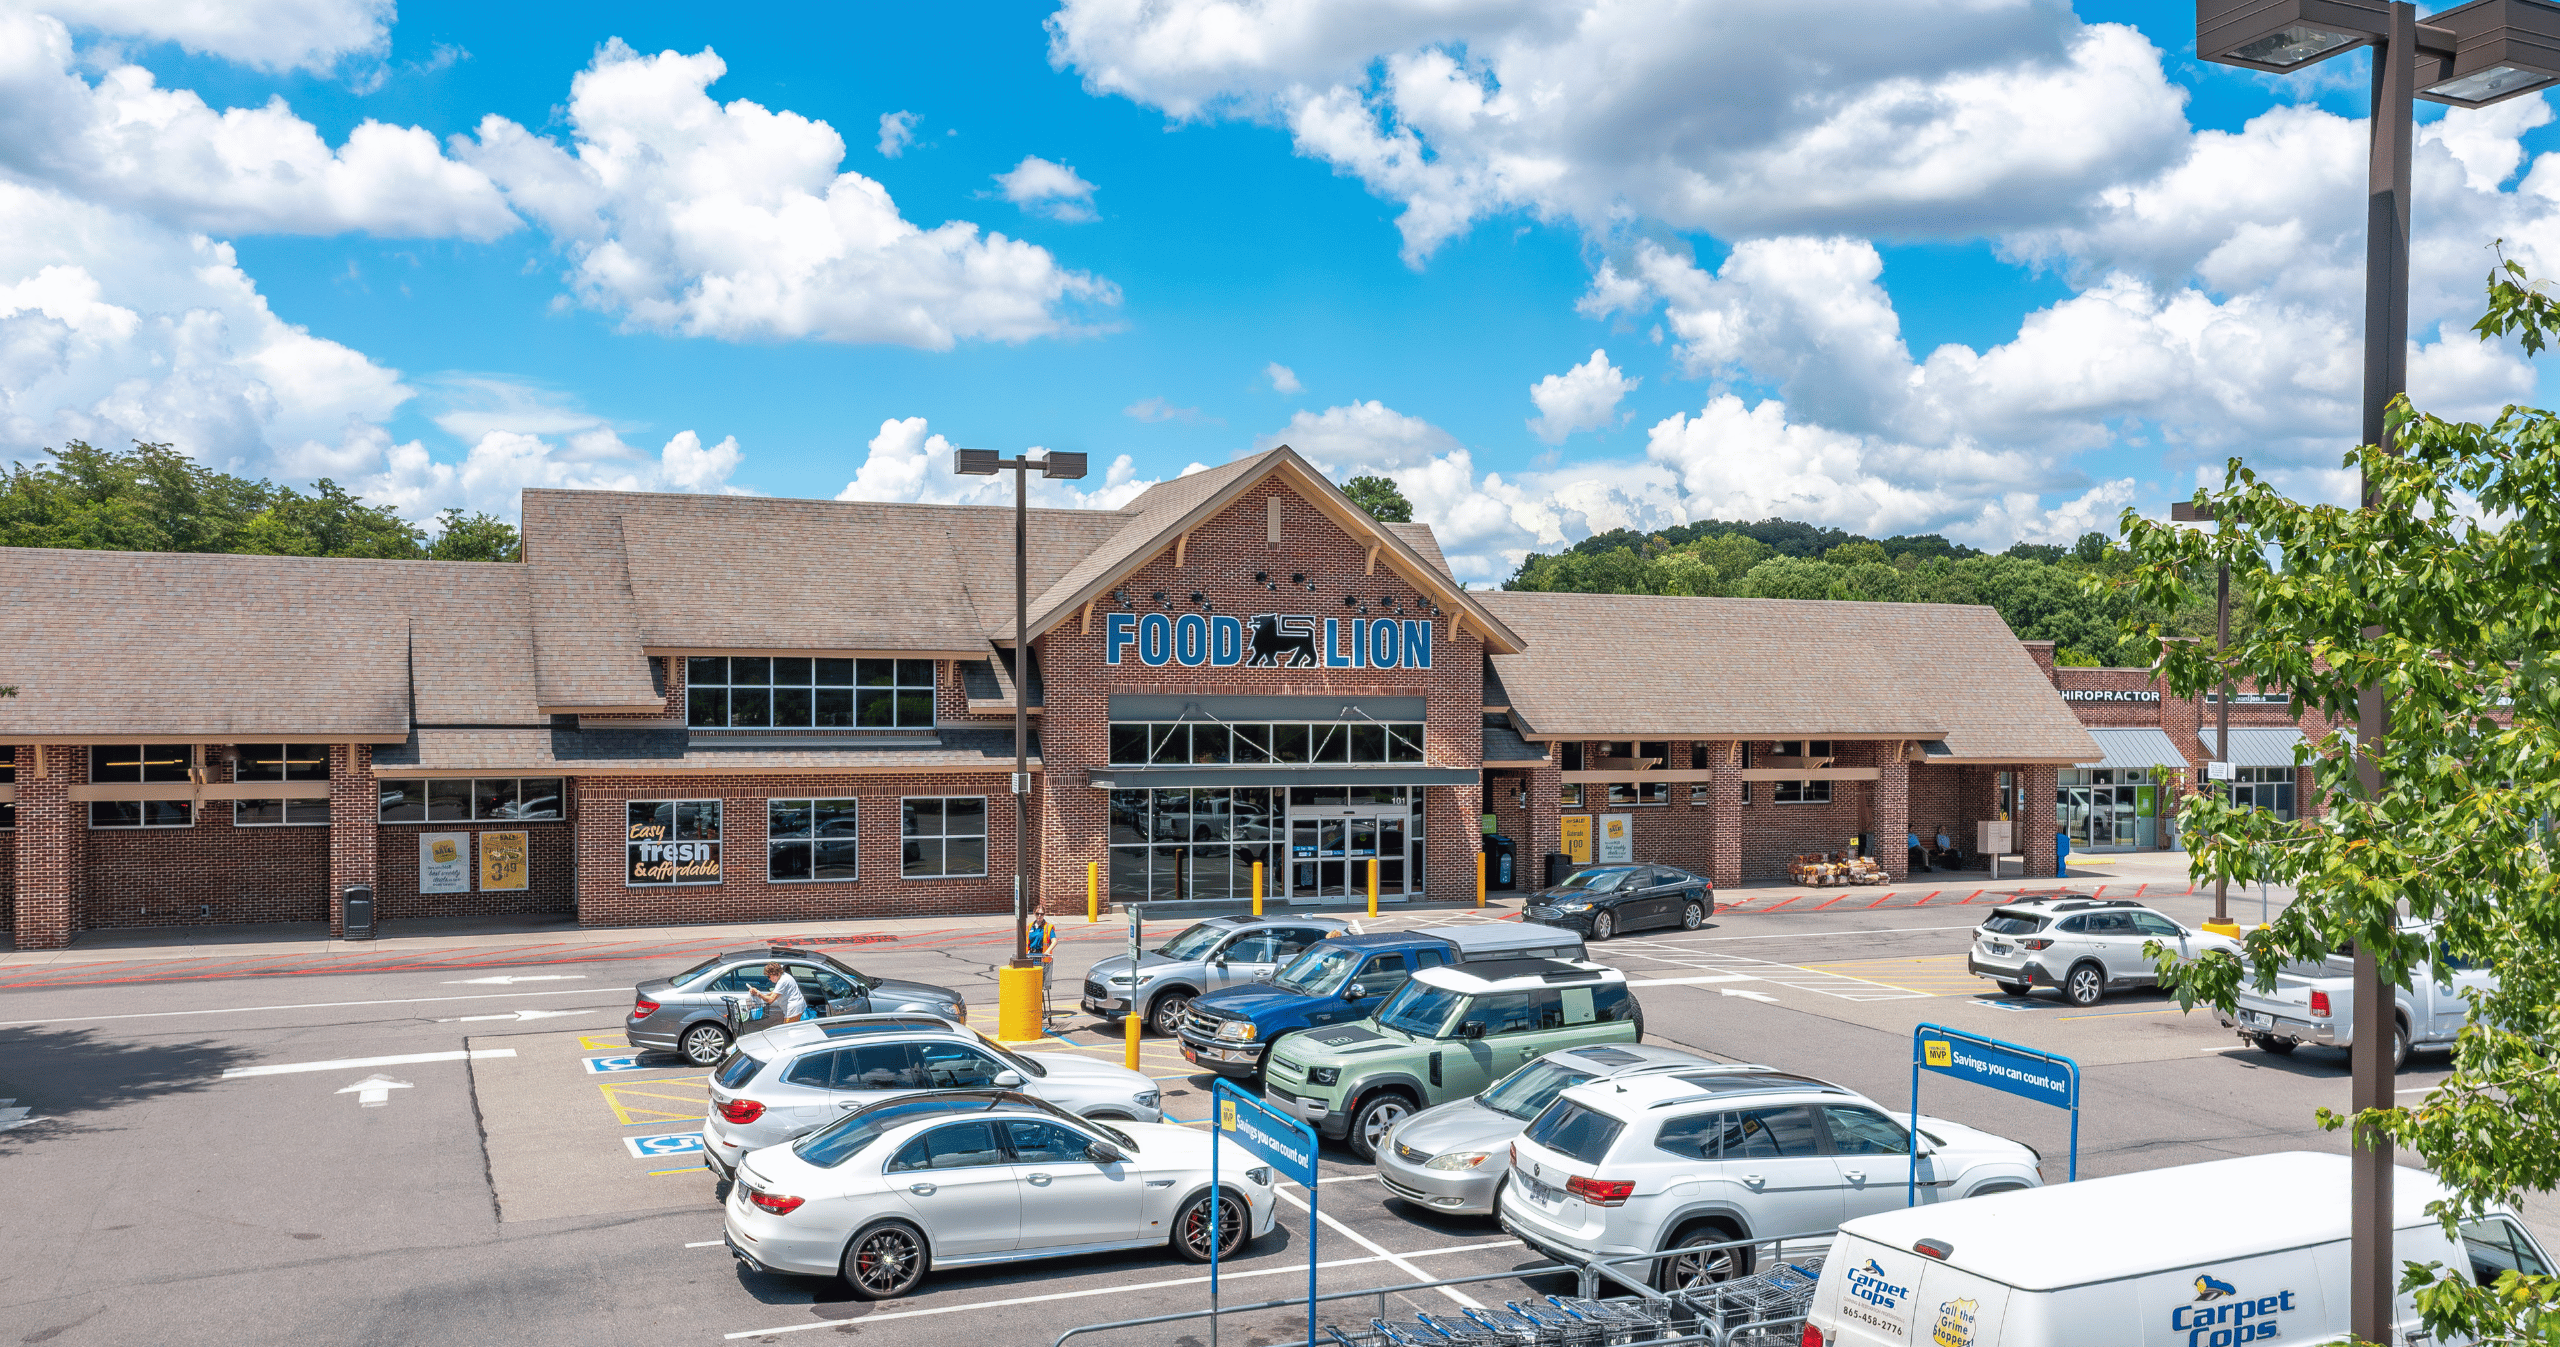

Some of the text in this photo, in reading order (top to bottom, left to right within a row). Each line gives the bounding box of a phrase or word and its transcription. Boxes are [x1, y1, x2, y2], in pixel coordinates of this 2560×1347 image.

[1106, 612, 1432, 669] FOOD LION
[2058, 690, 2160, 702] HIROPRACTOR
[1391, 797, 1406, 805] 101
[630, 823, 666, 845] Easy
[639, 838, 710, 862] fresh
[1929, 1050, 1947, 1060] MVP
[1953, 1051, 2065, 1093] Savings you can count on!
[1236, 1114, 1309, 1169] Savings you can count on!
[1847, 1267, 1910, 1300] Carpet
[1851, 1282, 1896, 1309] Cops
[1843, 1305, 1903, 1336] 865-458-2776
[1940, 1302, 1974, 1324] Call the
[2171, 1289, 2296, 1332] Carpet
[1941, 1316, 1969, 1335] Grime
[2188, 1319, 2278, 1347] Cops
